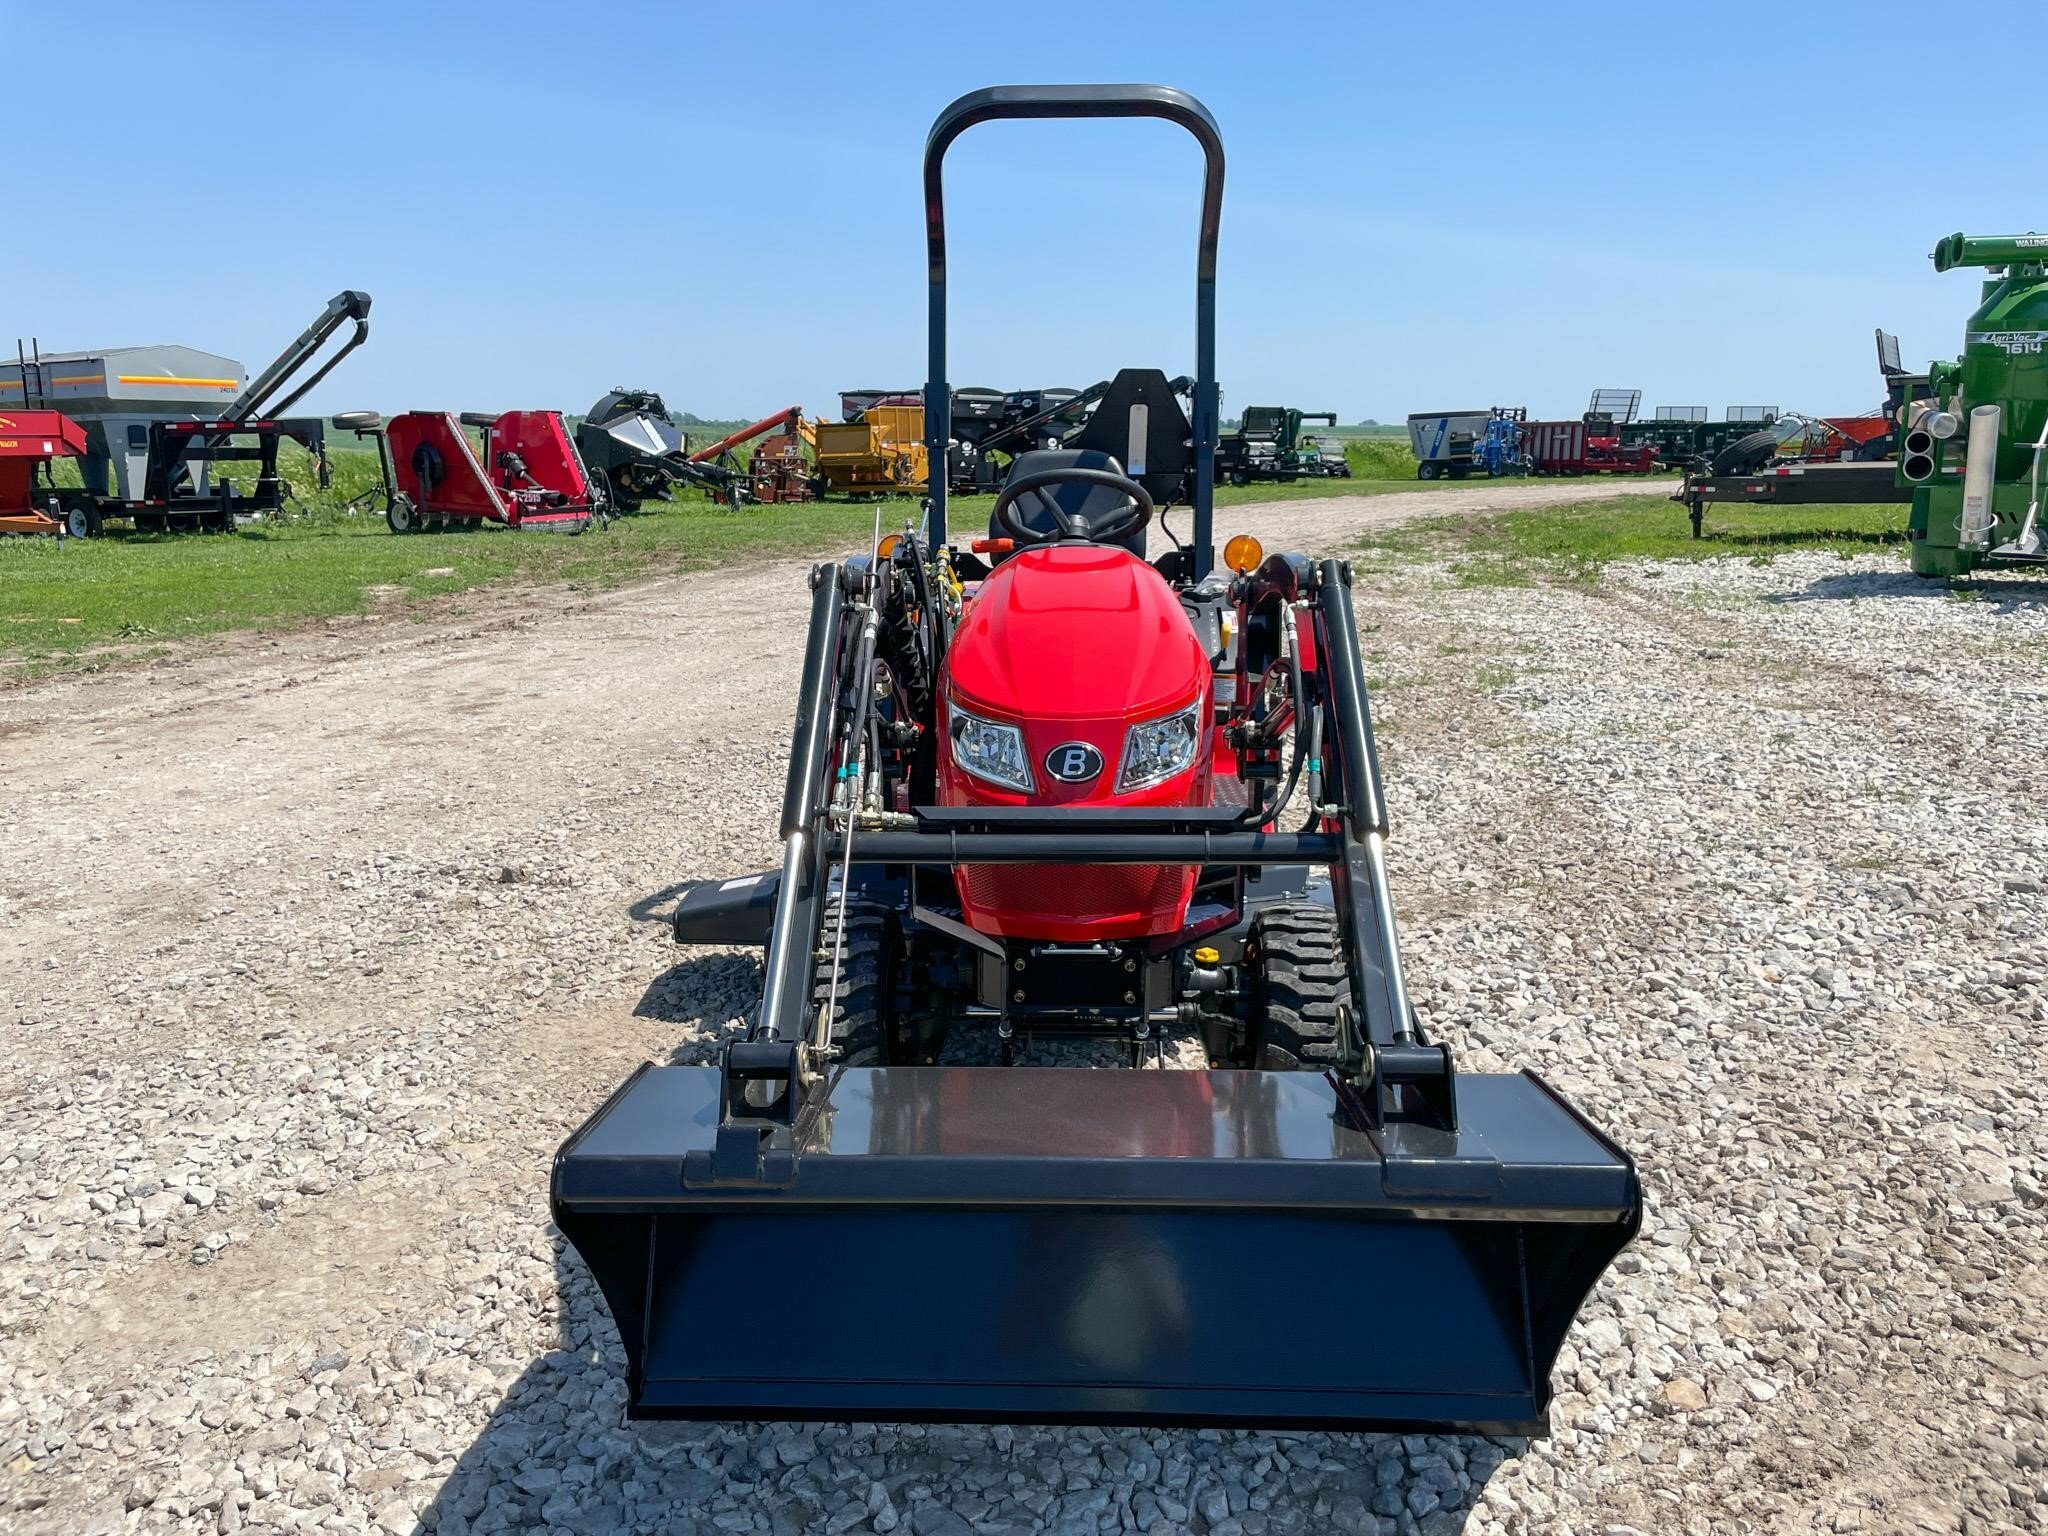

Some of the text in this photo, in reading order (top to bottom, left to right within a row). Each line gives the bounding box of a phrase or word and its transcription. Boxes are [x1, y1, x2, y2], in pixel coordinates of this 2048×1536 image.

[1989, 333, 2030, 347] Agri-Vac
[2000, 343, 2042, 354] 7614
[1062, 749, 1086, 776] B
